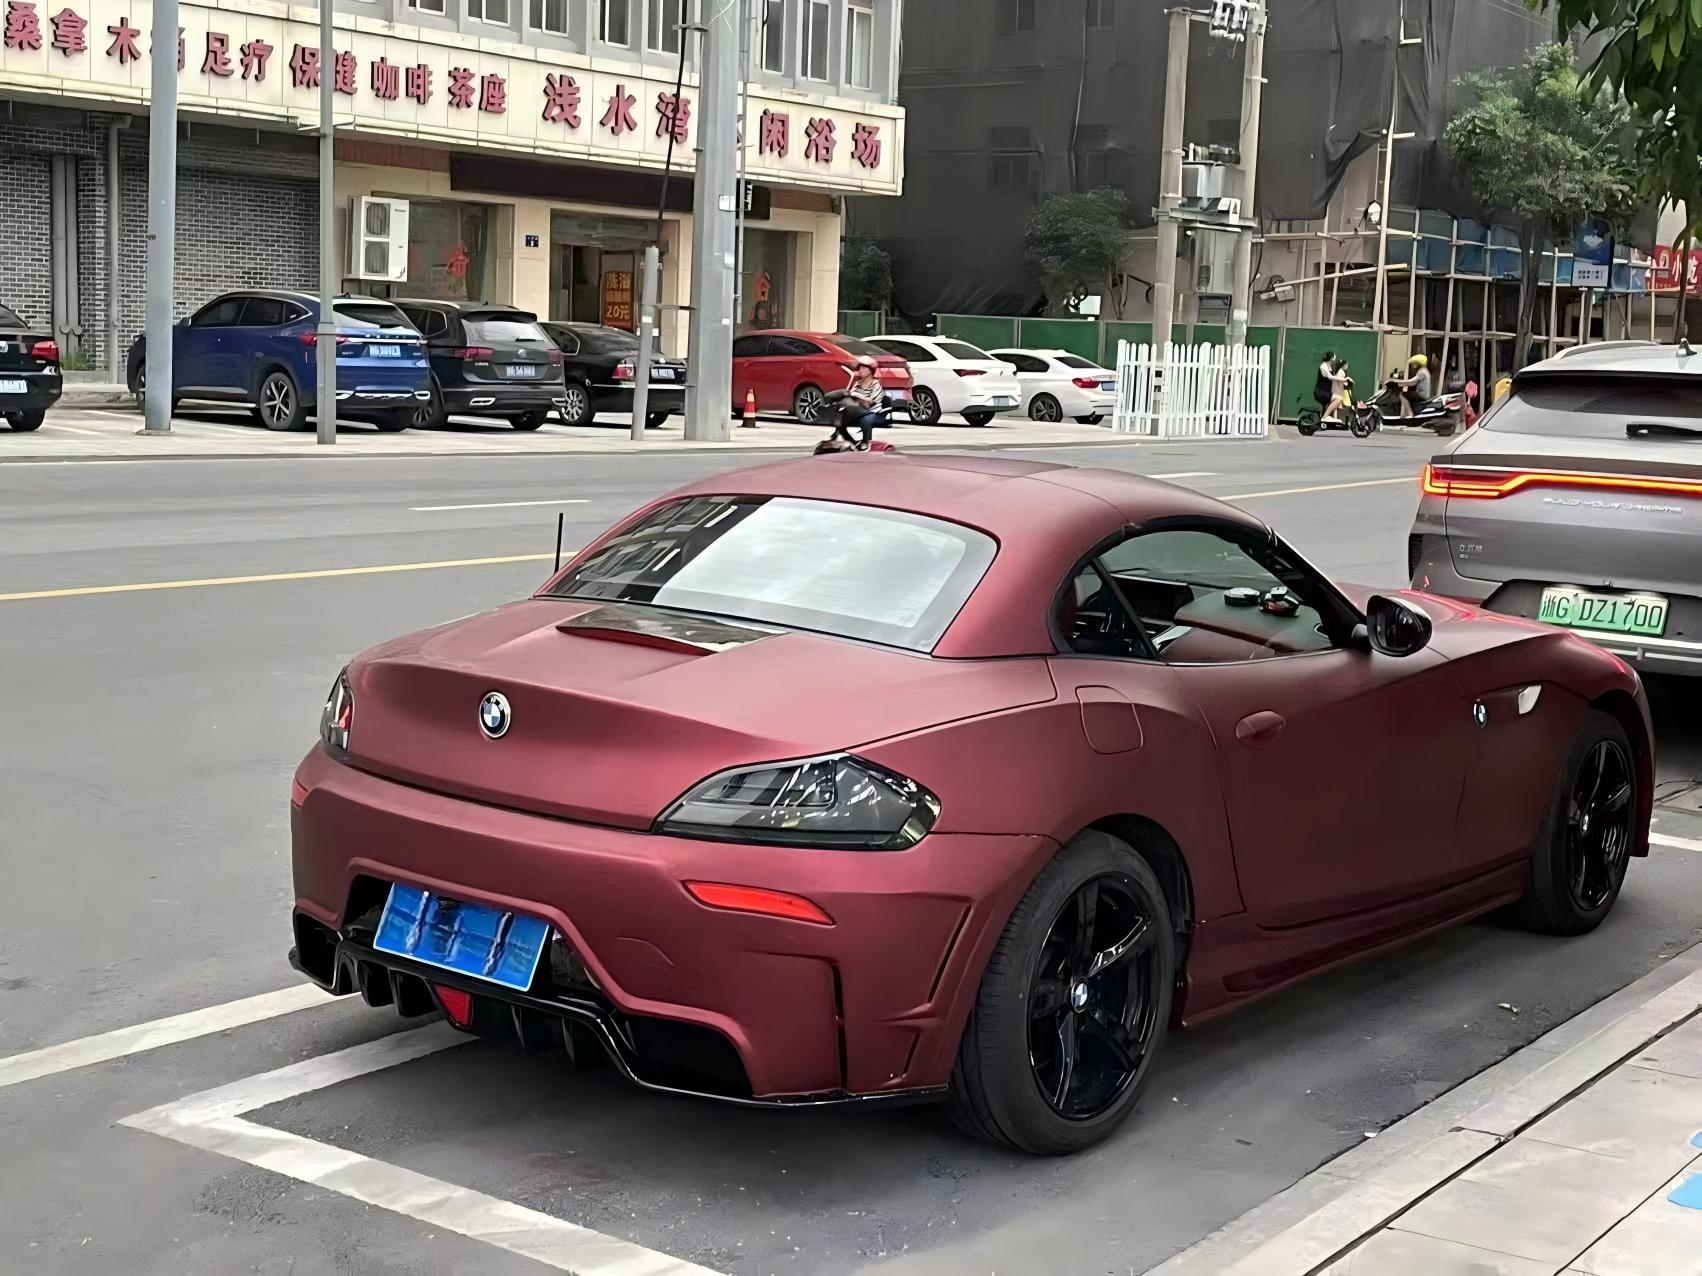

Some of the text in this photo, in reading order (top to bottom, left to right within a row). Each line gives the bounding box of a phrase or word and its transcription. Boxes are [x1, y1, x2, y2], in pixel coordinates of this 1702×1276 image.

[4, 1, 88, 57] 桑拿
[200, 31, 274, 82] 足疗
[370, 56, 434, 105] 咖啡
[448, 66, 507, 114] 茶座
